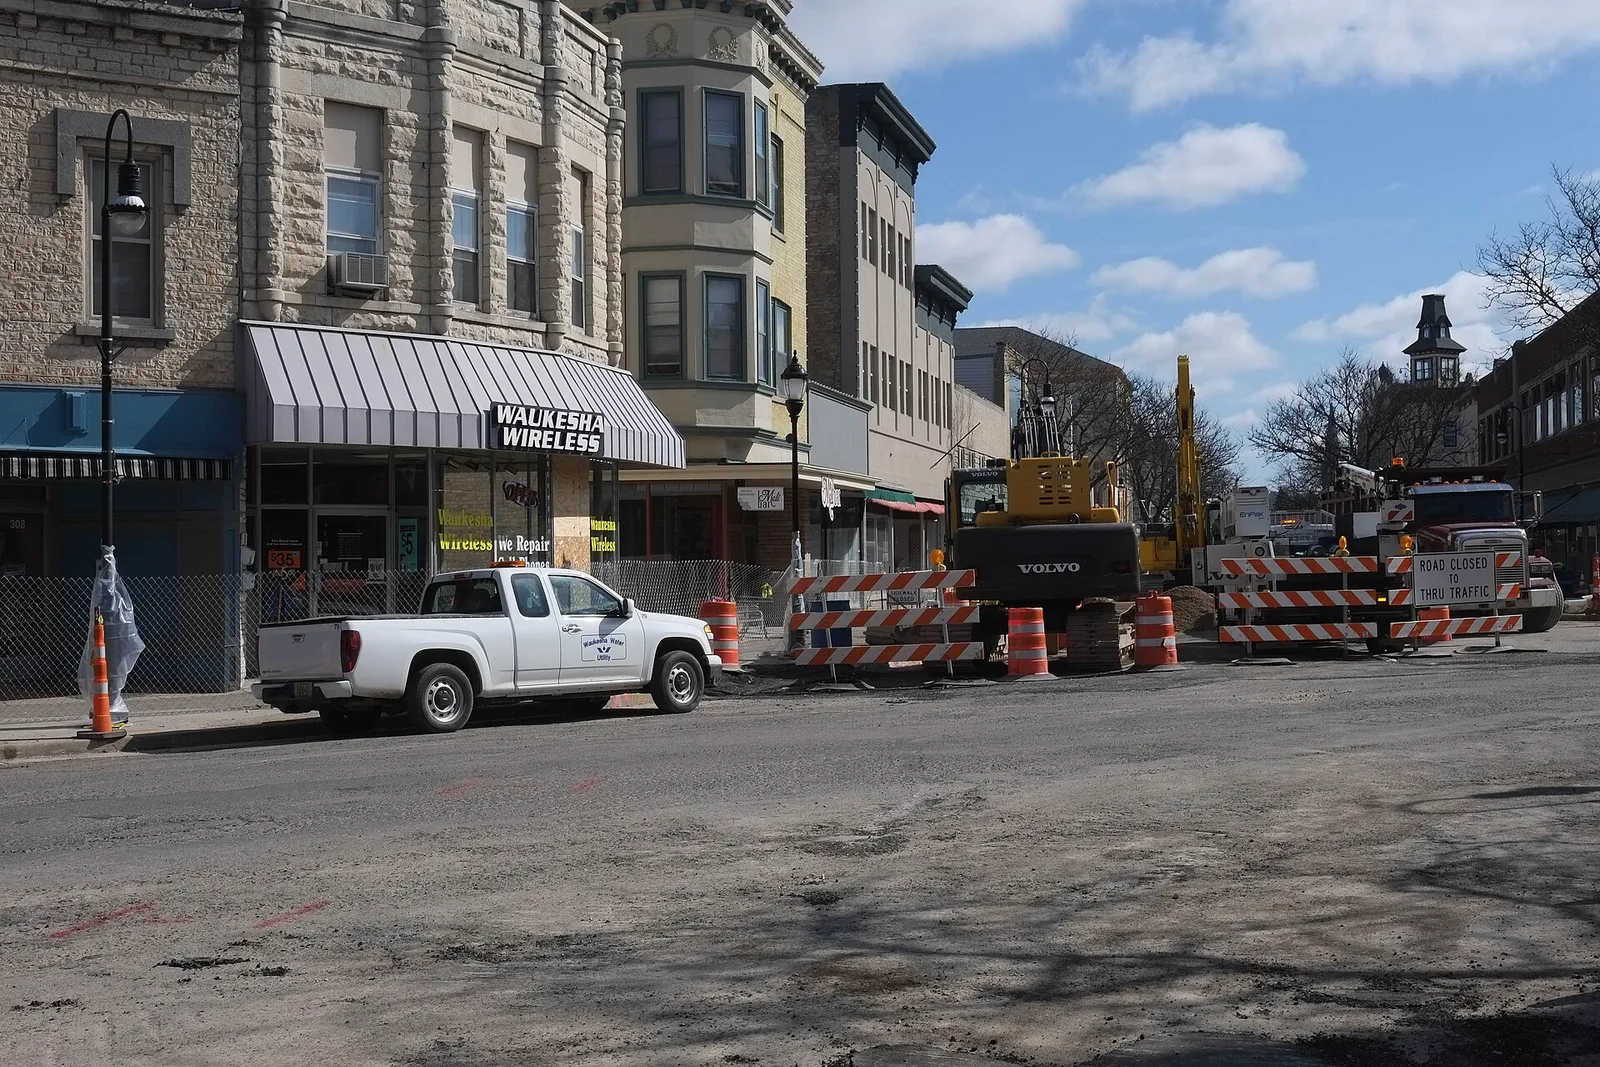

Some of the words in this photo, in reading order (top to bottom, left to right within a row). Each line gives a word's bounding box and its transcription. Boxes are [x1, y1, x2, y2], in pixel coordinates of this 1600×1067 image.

[497, 404, 604, 433] WAUKESHA
[503, 427, 601, 453] WIRELESS
[506, 483, 538, 506] OPEN
[757, 489, 772, 509] bar
[10, 519, 26, 529] 308
[437, 508, 494, 527] Waukesha
[590, 516, 616, 531] Waukesha
[401, 532, 413, 555] $5
[438, 532, 493, 551] Wireless
[498, 535, 513, 552] We
[516, 535, 550, 554] Repair
[590, 536, 616, 552] Wireless
[271, 552, 294, 566] $35
[1420, 560, 1446, 573] ROAD
[1450, 557, 1488, 571] CLOSED
[1018, 562, 1081, 574] VOLVO
[1448, 573, 1459, 584] TO
[1420, 587, 1445, 600] THRU
[1450, 585, 1490, 598] TRAFFIC
[583, 637, 608, 648] Waukesha
[610, 638, 625, 647] Water
[596, 654, 611, 662] Utility
